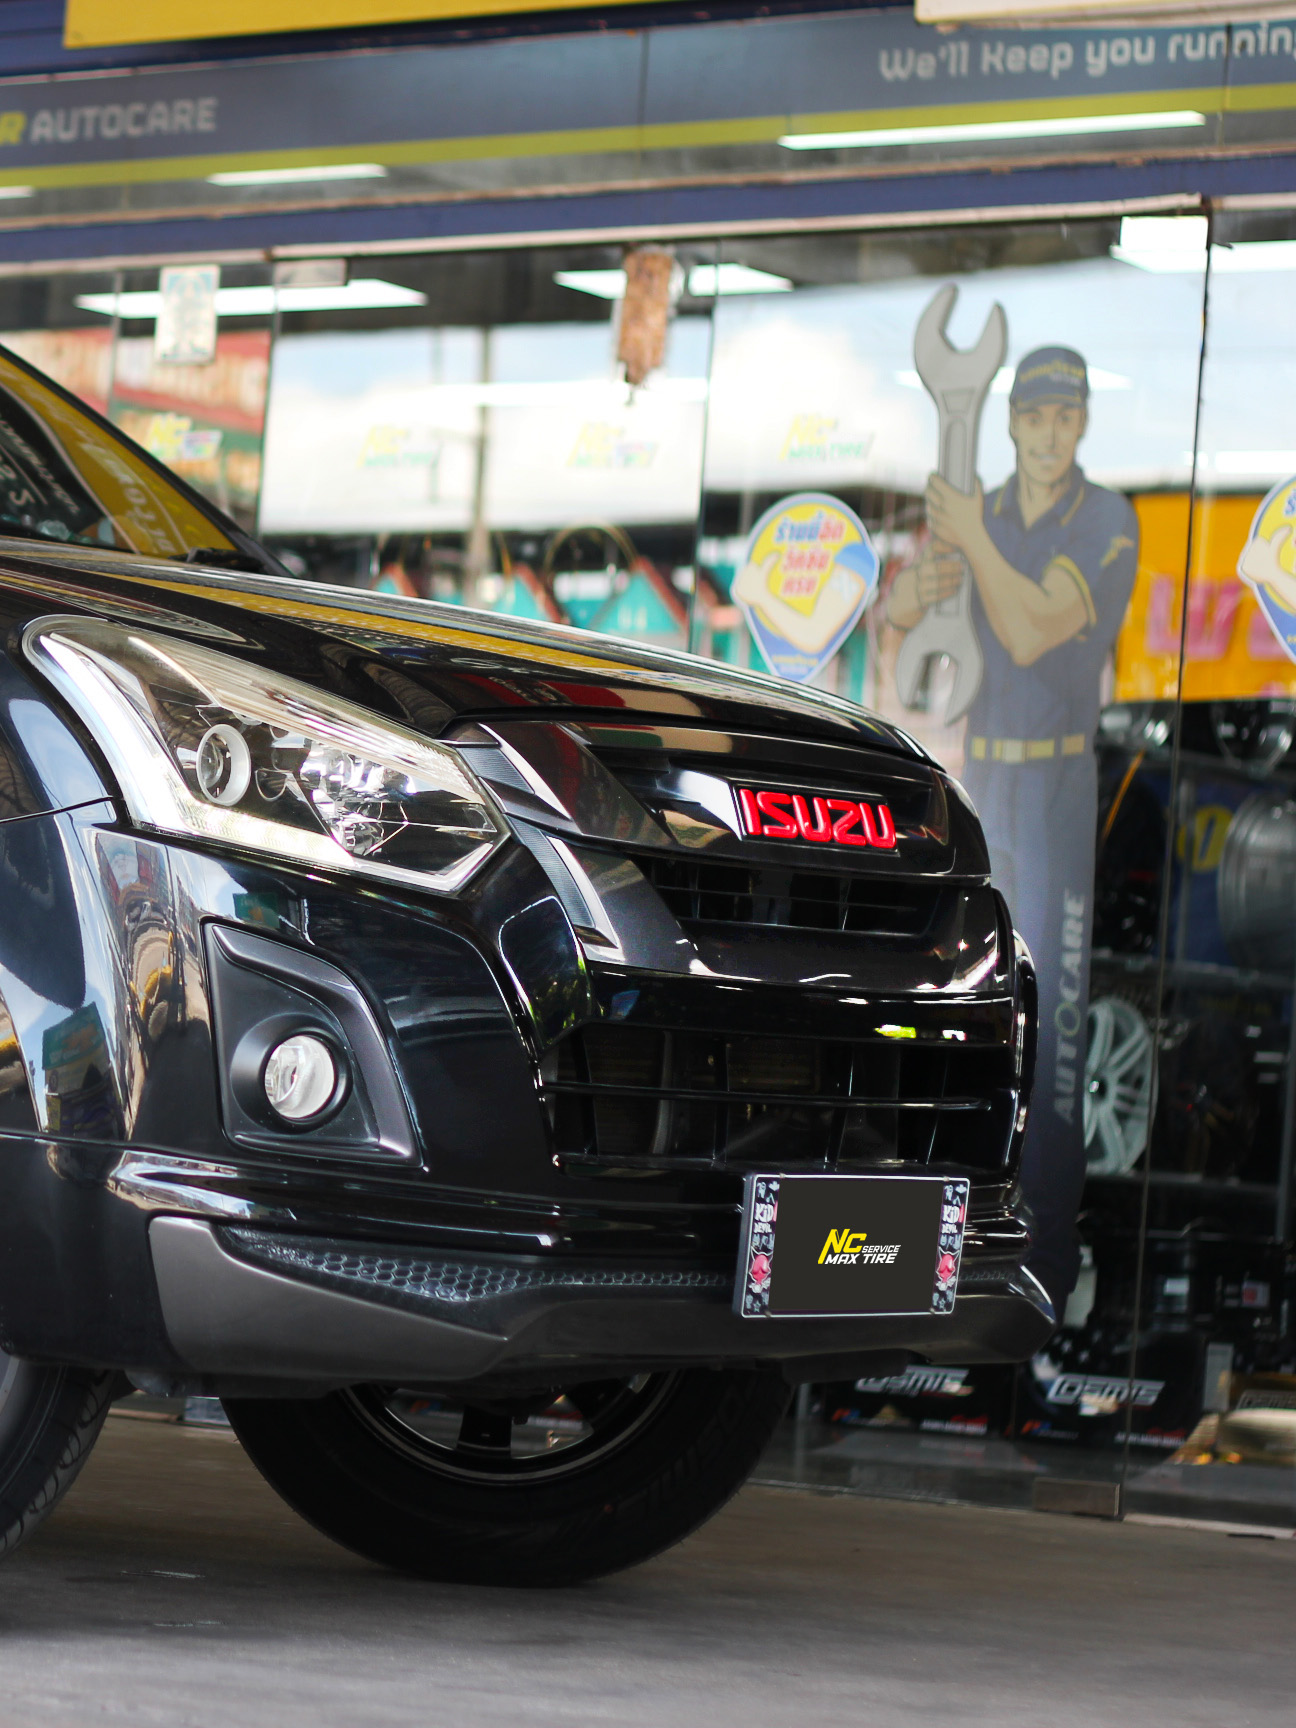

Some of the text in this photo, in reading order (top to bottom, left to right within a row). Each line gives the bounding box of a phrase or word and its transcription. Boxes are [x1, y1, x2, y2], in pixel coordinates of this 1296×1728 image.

[878, 21, 1296, 82] We'll Keep you runnin
[30, 98, 218, 144] AUTOCARE
[739, 788, 897, 849] ISUZU
[1047, 1372, 1166, 1405] COSMIS
